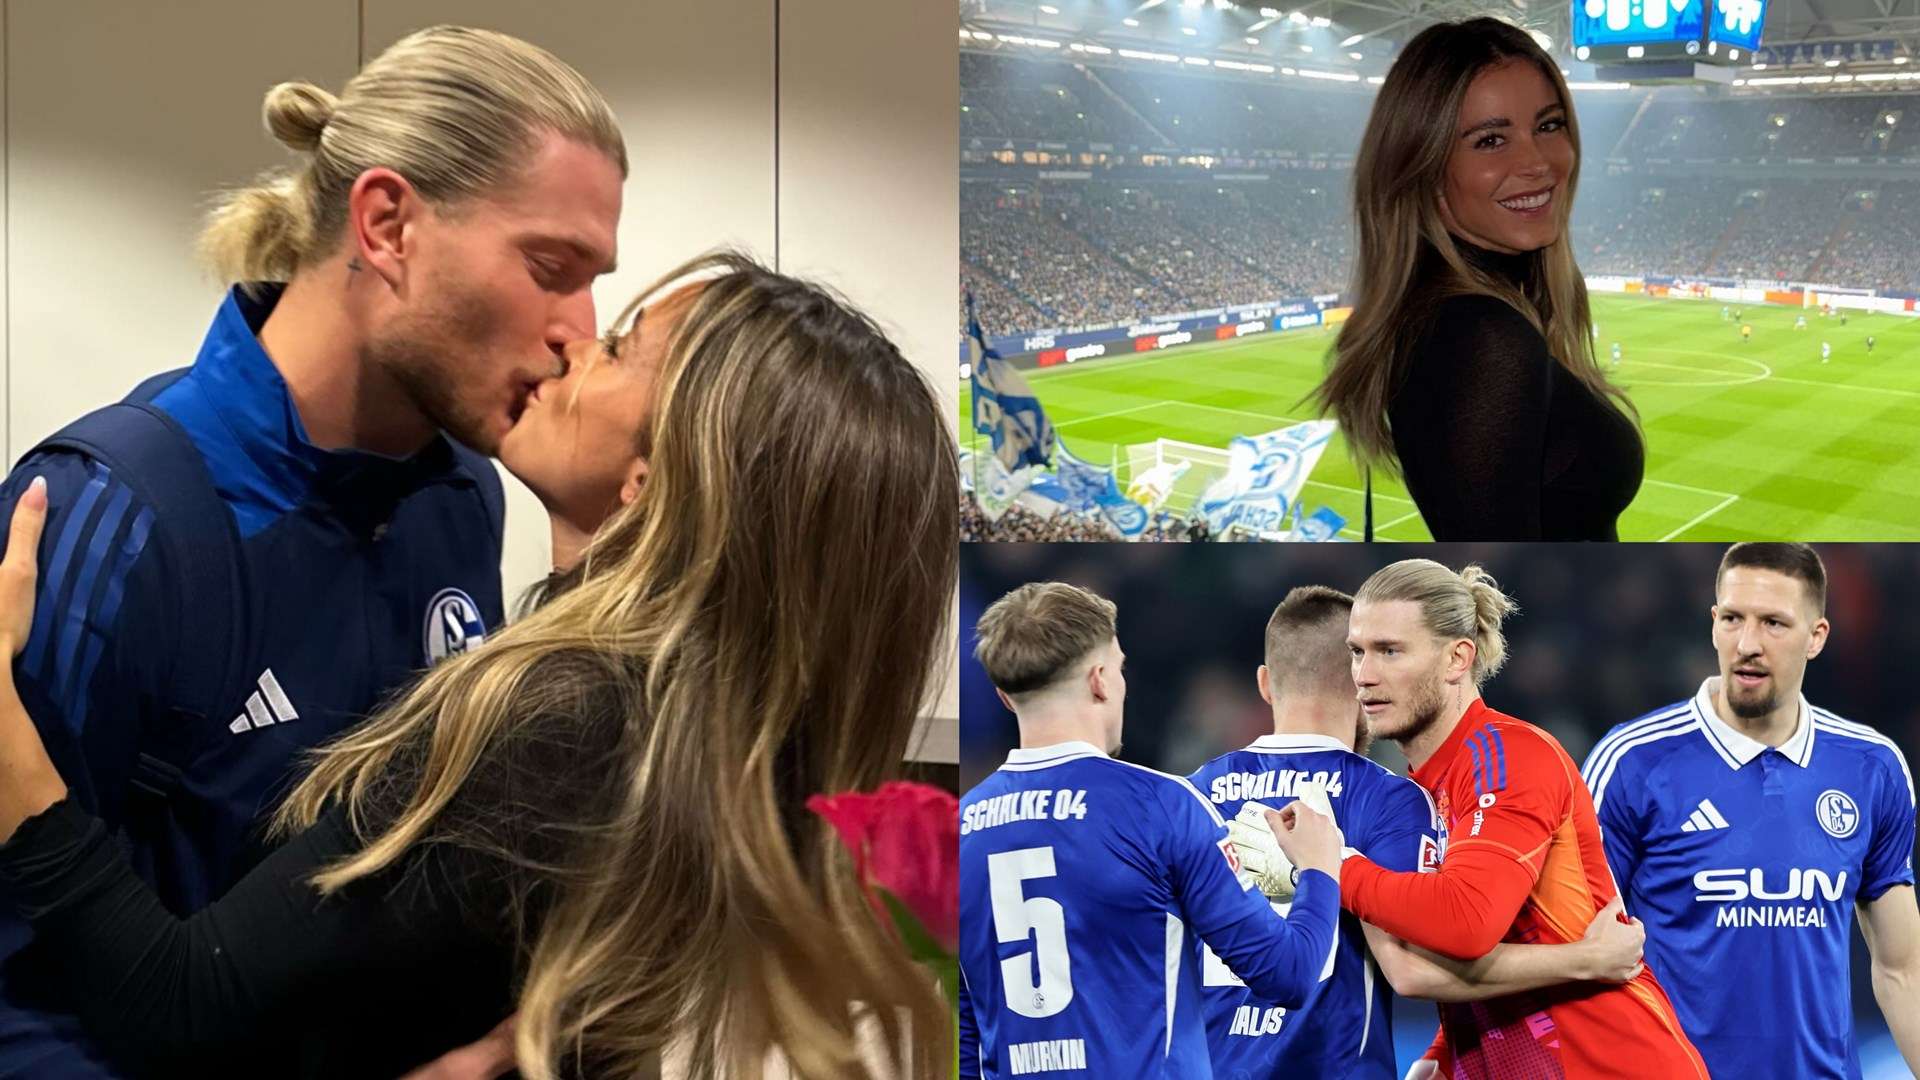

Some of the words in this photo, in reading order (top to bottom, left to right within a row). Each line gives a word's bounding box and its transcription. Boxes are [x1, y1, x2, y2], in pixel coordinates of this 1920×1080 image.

[1024, 336, 1056, 351] HRS
[960, 790, 1052, 835] SCHALKE
[1053, 789, 1088, 820] 04
[1693, 867, 1847, 902] SUN
[987, 846, 1074, 1018] 5
[1715, 906, 1827, 928] MINIMEAL
[1008, 1039, 1087, 1075] MURKIN
